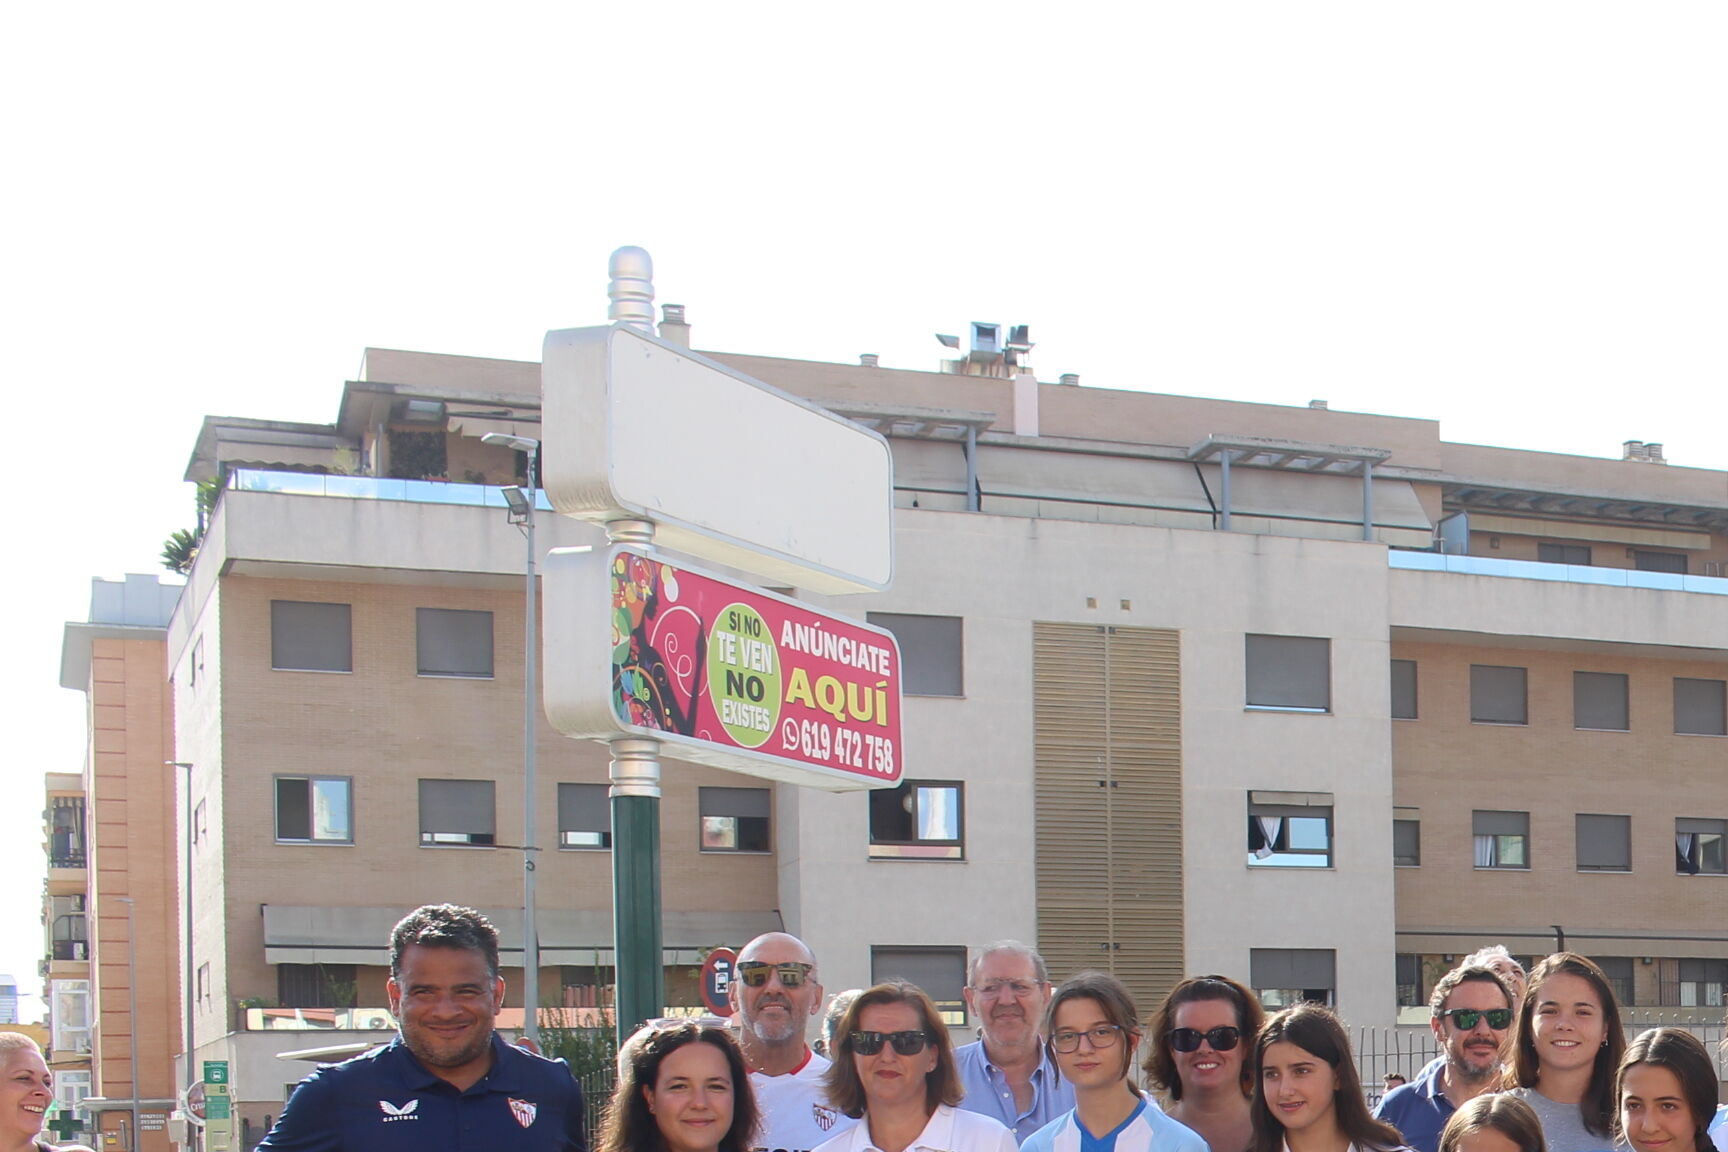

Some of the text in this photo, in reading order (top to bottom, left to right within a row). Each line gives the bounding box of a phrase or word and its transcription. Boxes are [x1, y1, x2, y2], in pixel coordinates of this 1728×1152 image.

[729, 611, 761, 637] SI NO
[716, 630, 773, 674] TE VEN
[780, 620, 891, 676] ANÚNCIATE
[726, 669, 765, 702] NO
[785, 667, 888, 726] AQUÍ
[721, 699, 771, 732] EXISTES
[801, 719, 894, 774] 619 472 758
